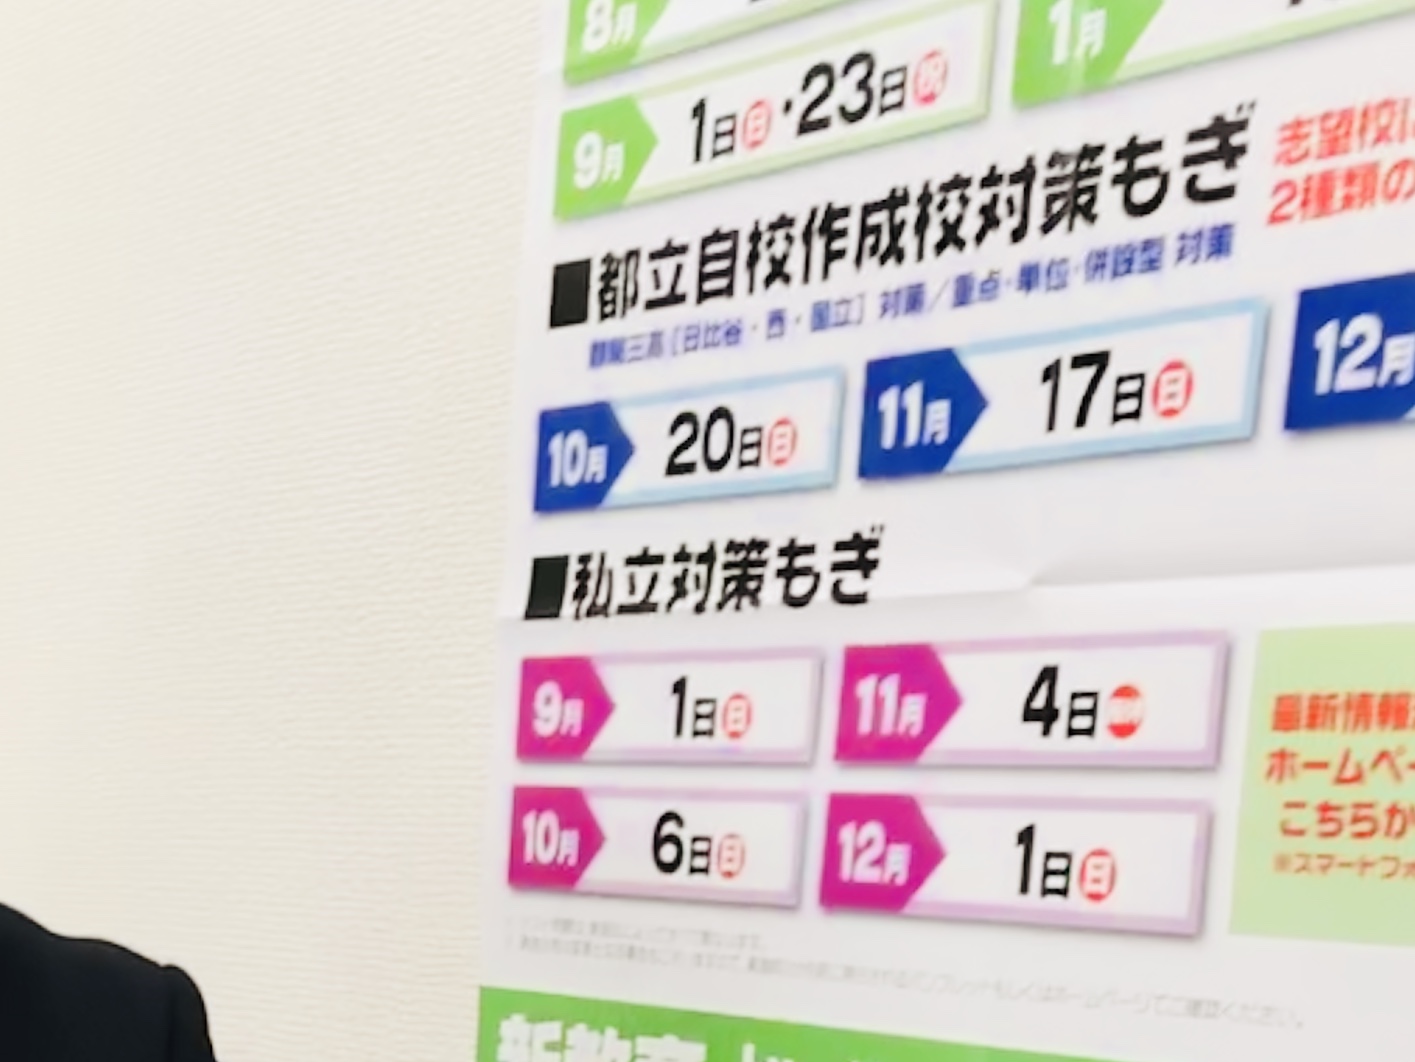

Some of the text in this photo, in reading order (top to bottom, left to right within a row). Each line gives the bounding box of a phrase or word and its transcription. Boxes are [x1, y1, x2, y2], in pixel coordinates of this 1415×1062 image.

[573, 131, 626, 190] 9月
[1314, 312, 1415, 395] 12月
[877, 382, 950, 450] 11月
[547, 431, 607, 487] 10月
[572, 525, 884, 619] 私立対策もぎ
[532, 681, 584, 738] 9月
[855, 675, 926, 737] 11月
[1272, 692, 1415, 733] 最新情報
[1266, 746, 1415, 785] ホームペ
[522, 813, 579, 866] 10月
[839, 824, 909, 884] 12月
